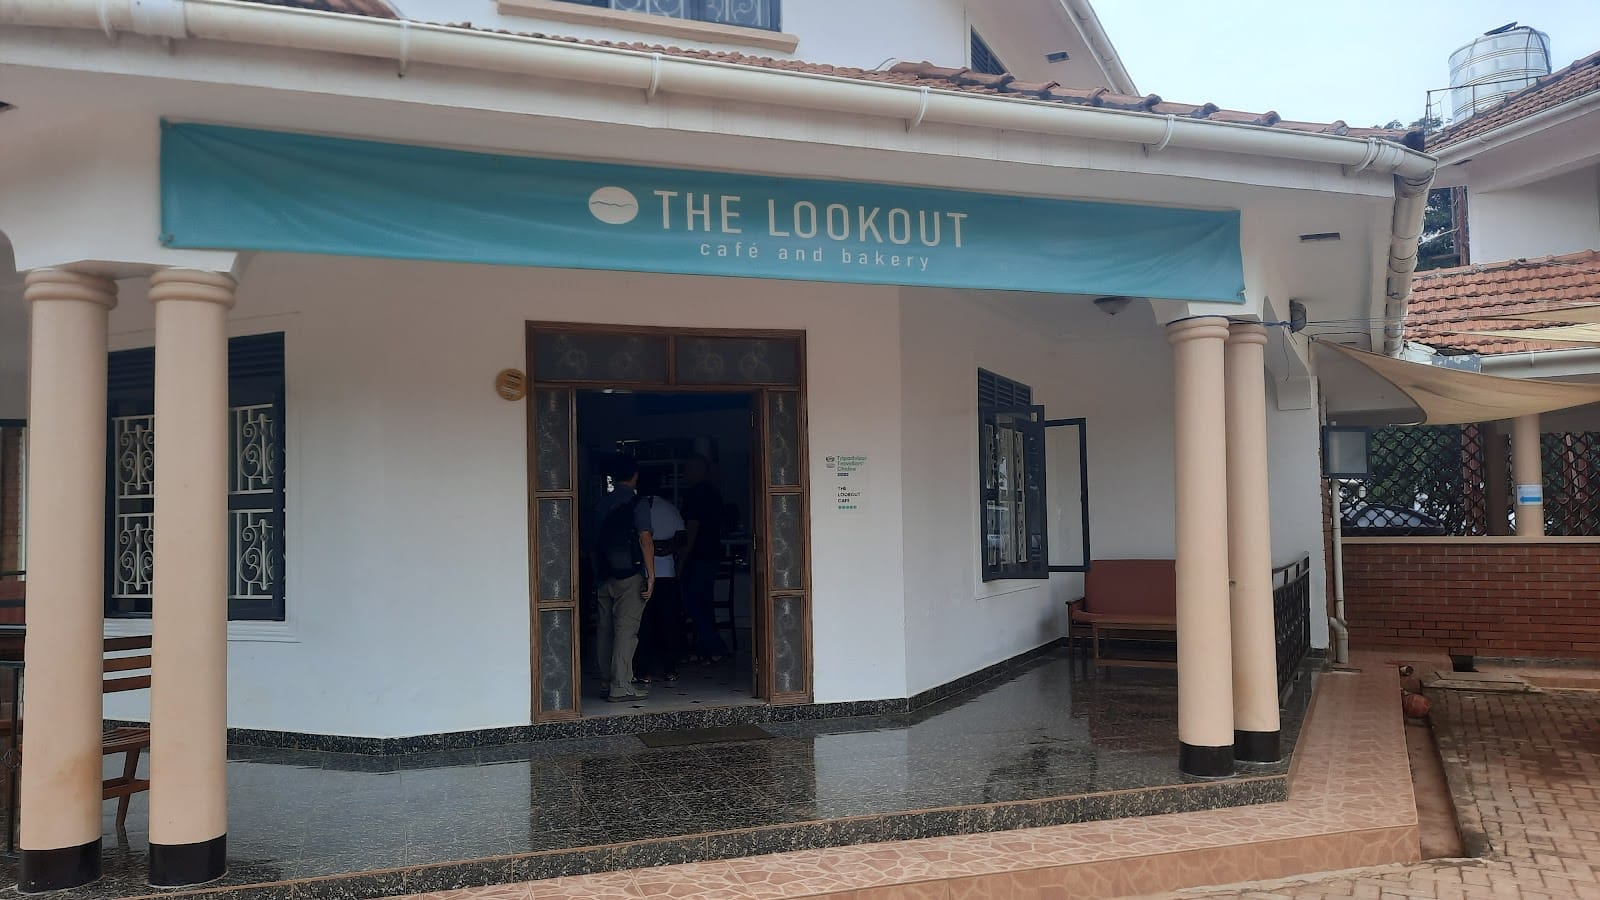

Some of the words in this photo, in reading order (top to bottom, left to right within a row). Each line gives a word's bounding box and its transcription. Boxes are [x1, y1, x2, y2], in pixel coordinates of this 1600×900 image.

[653, 189, 742, 234] THE
[768, 198, 968, 248] LOOKOUT
[700, 242, 758, 258] café
[778, 247, 823, 262] and
[842, 248, 929, 271] bakery
